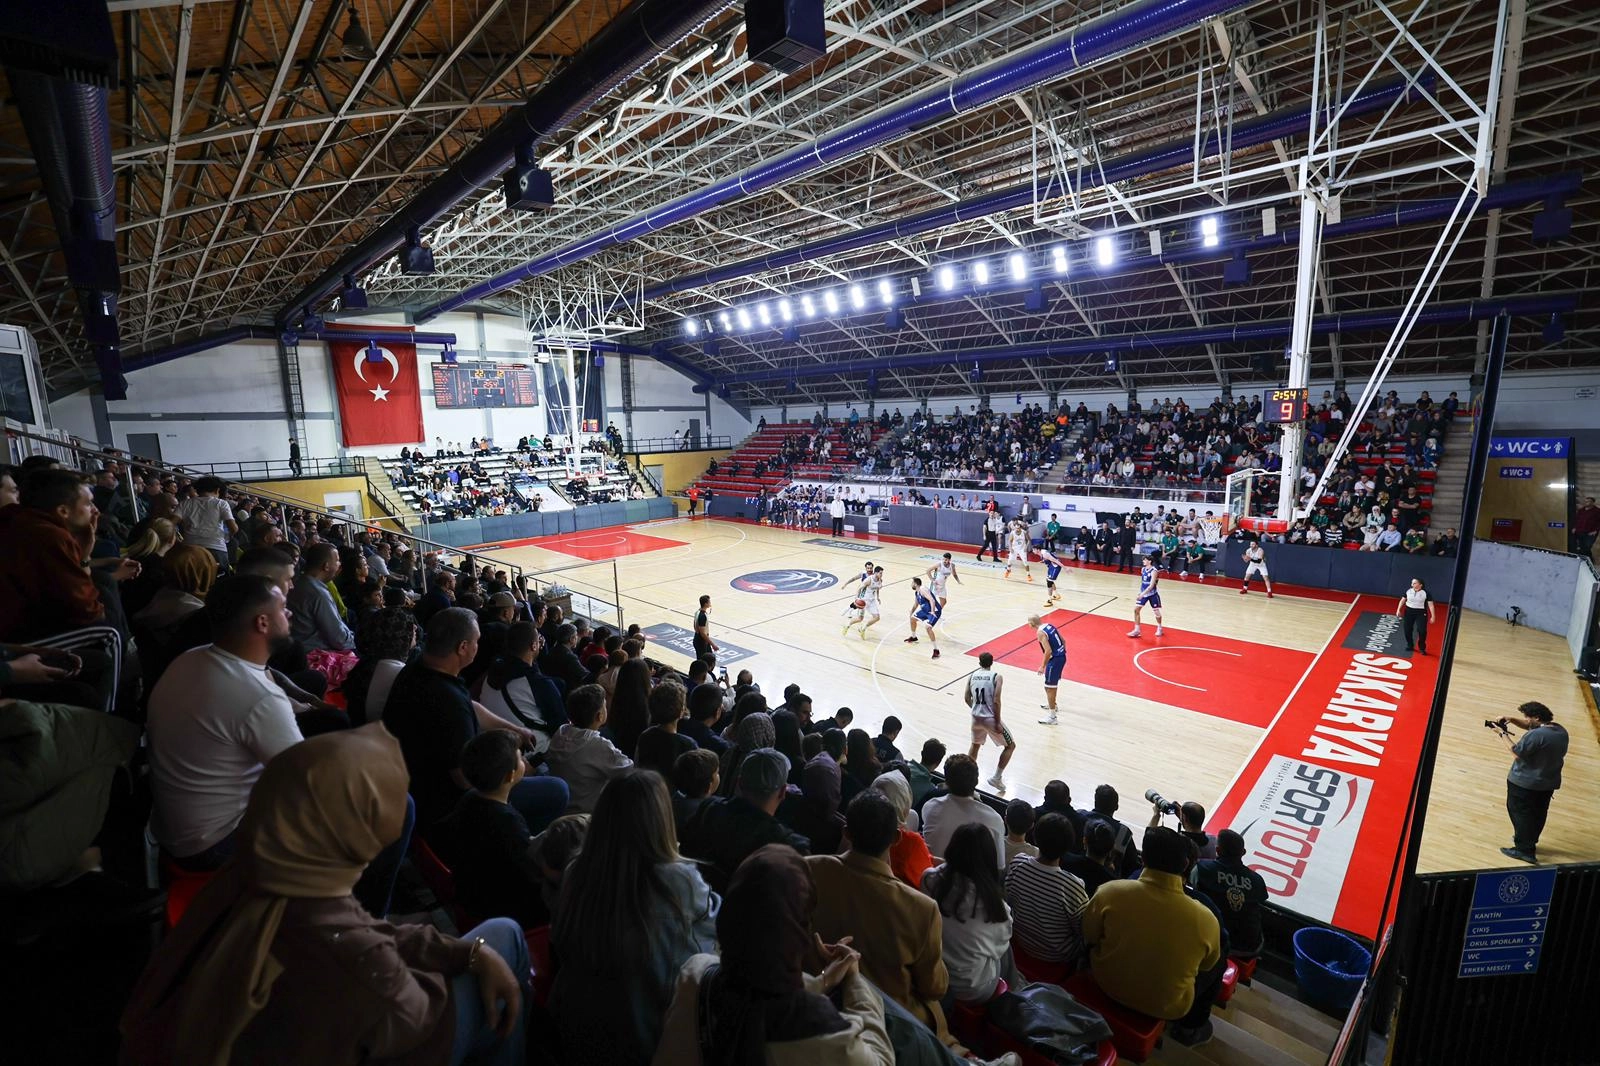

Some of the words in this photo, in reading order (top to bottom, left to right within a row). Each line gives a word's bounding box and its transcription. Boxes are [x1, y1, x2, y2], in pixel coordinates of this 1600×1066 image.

[1272, 390, 1297, 401] 2:54
[1280, 402, 1293, 420] 9
[1508, 442, 1540, 454] WC
[1509, 468, 1524, 477] WC
[975, 687, 987, 704] 11
[1301, 653, 1413, 767] SAKARYA
[1474, 912, 1502, 920] KANTİN
[1472, 926, 1490, 934] ÇIKIŞ
[1490, 938, 1524, 946] SPORLARI
[1464, 966, 1486, 974] ERKEK
[1486, 964, 1511, 972] MESCİT
